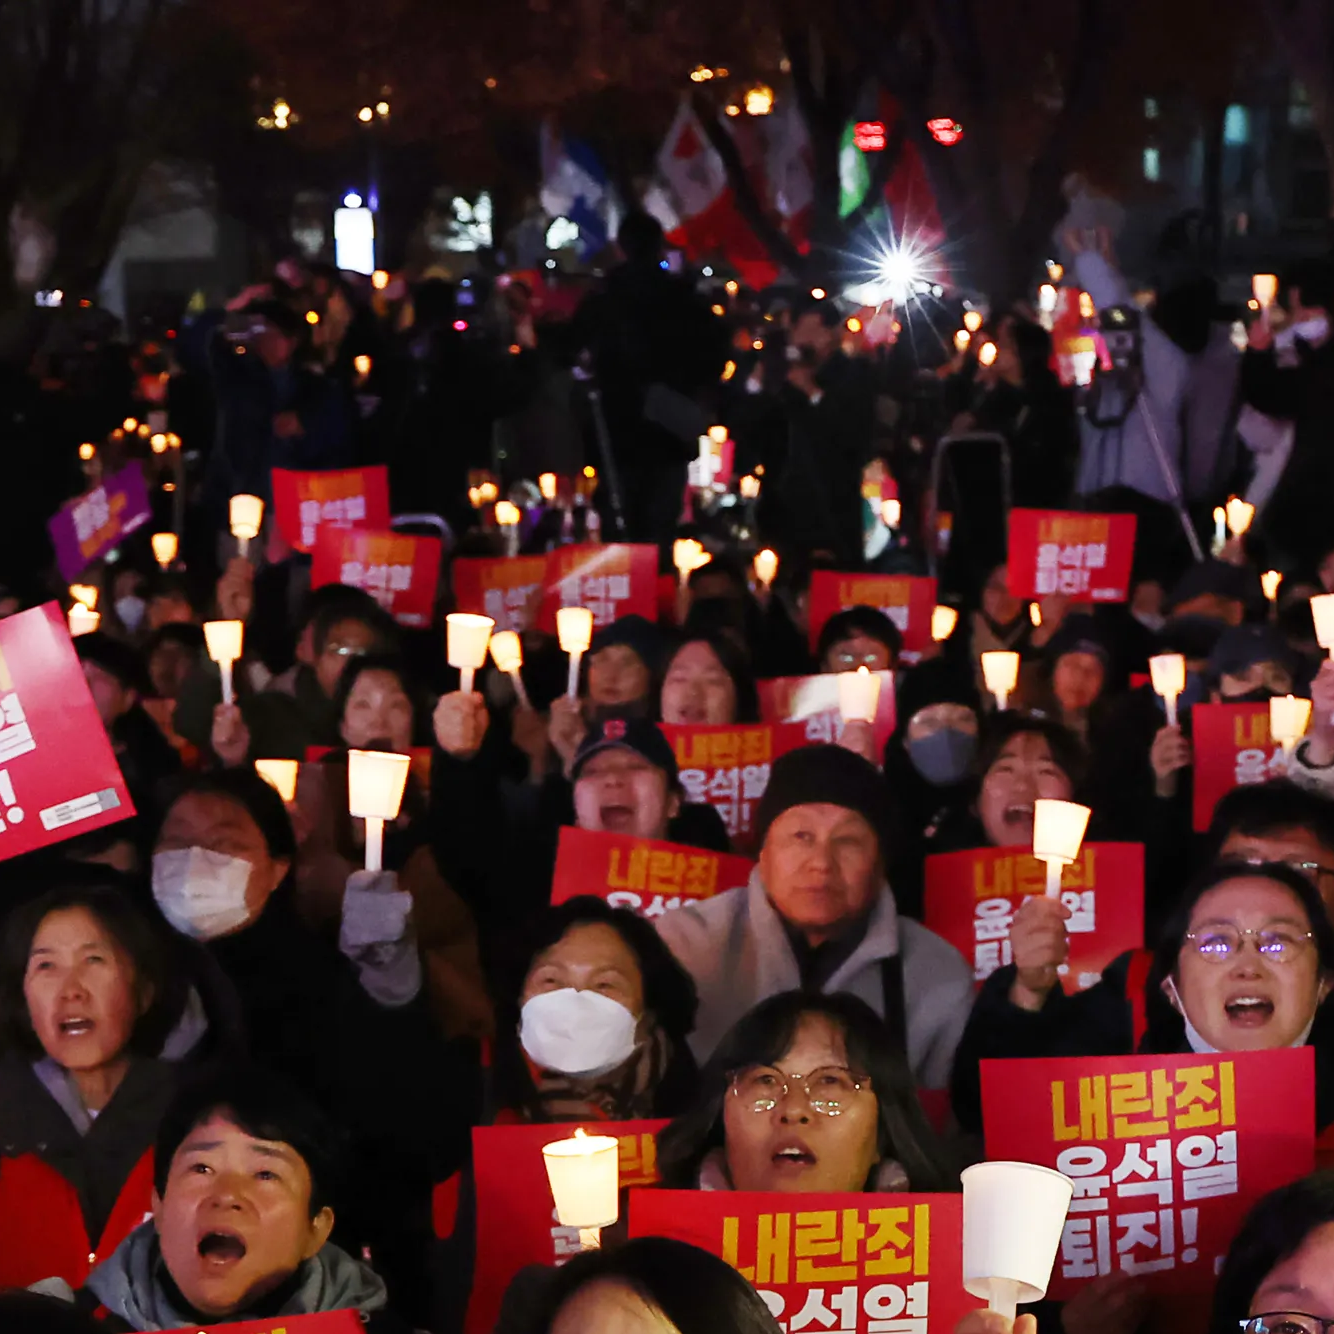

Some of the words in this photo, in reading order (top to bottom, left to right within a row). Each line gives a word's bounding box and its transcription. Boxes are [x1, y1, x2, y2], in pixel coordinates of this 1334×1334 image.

[607, 845, 718, 896] 내란죄
[974, 891, 1095, 946] 윤열
[1053, 1061, 1236, 1141] 내란죄
[1055, 1130, 1238, 1213] 윤석열
[722, 1205, 930, 1284] 내란죄
[1062, 1207, 1198, 1278] 퇴진!
